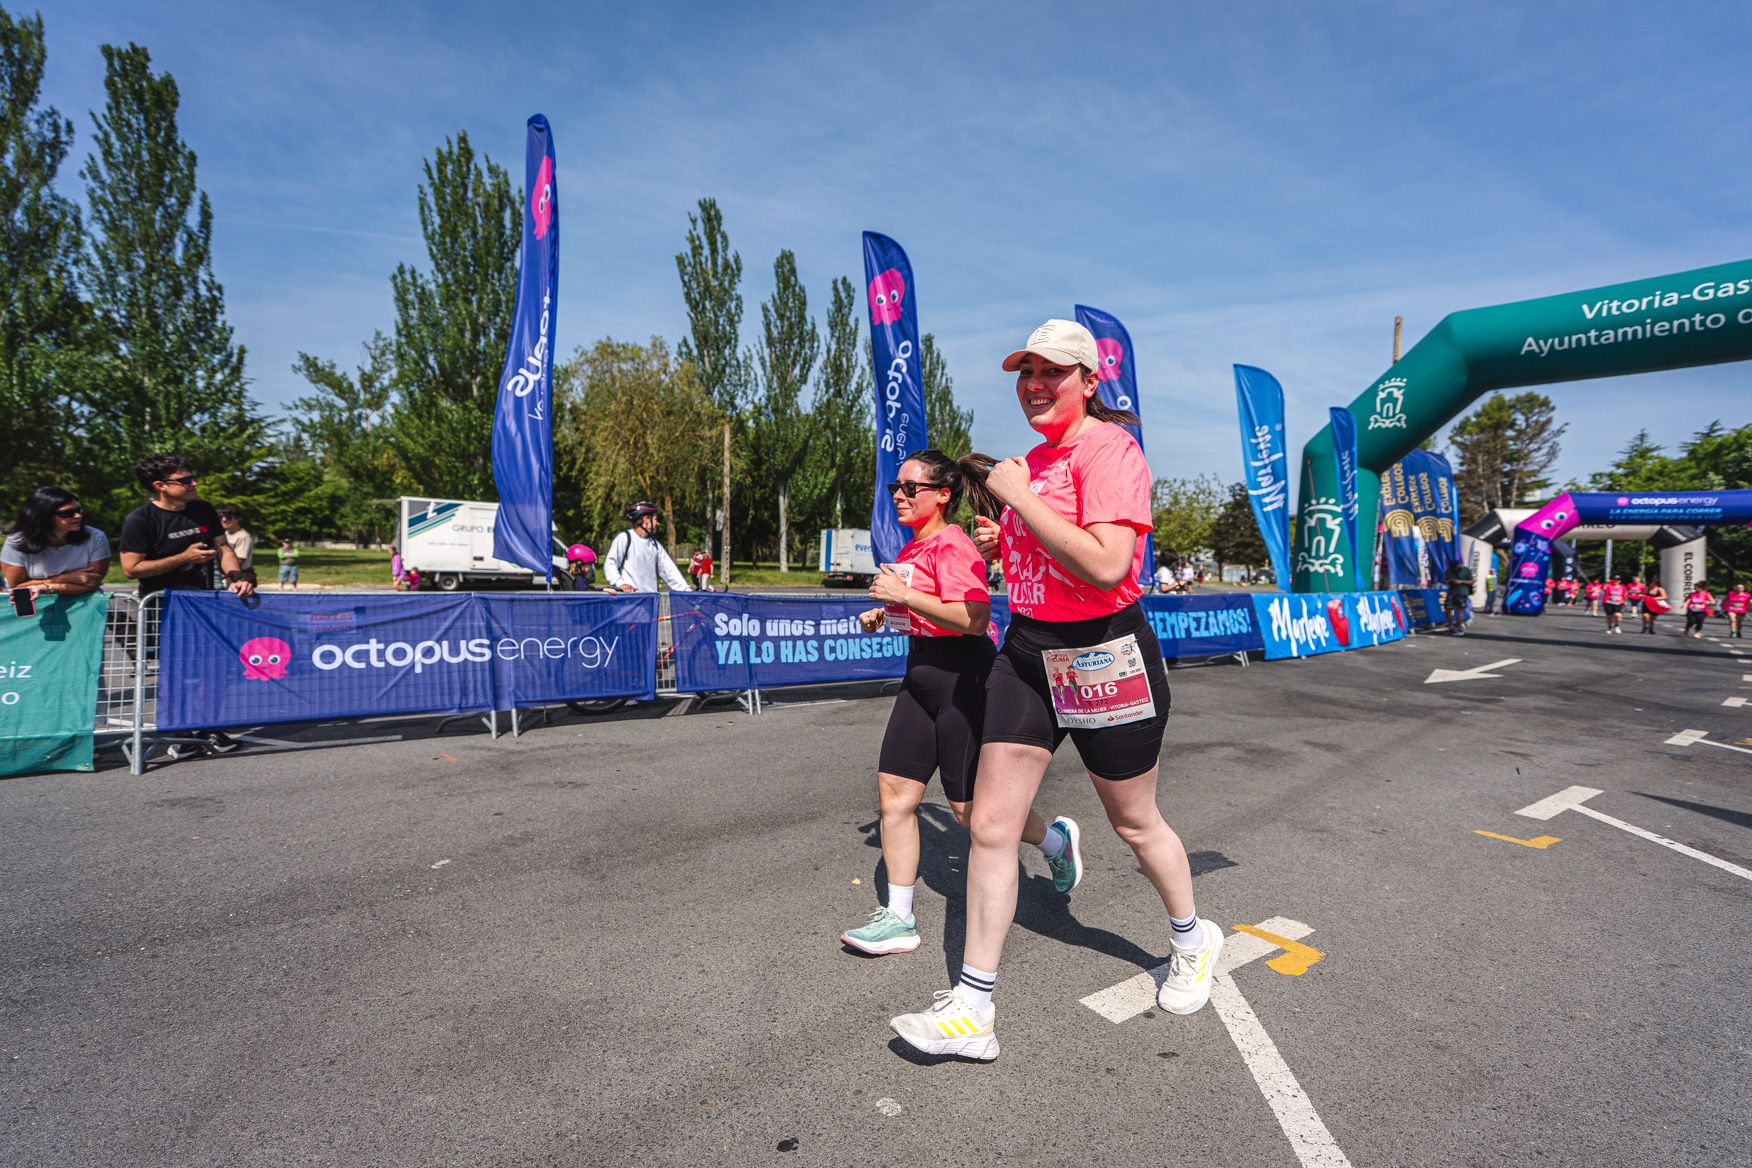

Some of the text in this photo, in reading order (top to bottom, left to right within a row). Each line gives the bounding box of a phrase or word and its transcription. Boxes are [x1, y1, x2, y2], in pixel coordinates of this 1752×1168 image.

[1581, 278, 1752, 320] Vitoria-Gas
[1520, 313, 1726, 357] Ayuntamiento
[1631, 497, 1718, 506] octopus energy
[452, 524, 483, 533] GRUPO
[1684, 552, 1694, 562] EL
[714, 612, 760, 637] Solo
[766, 619, 815, 637] unos
[312, 636, 618, 673] octopus energy
[715, 634, 910, 665] YA LO HAS CONSEGUI
[1076, 657, 1112, 668] ASTURIANA
[1080, 681, 1118, 699] 016
[1067, 709, 1144, 725] OYSHO Santander
